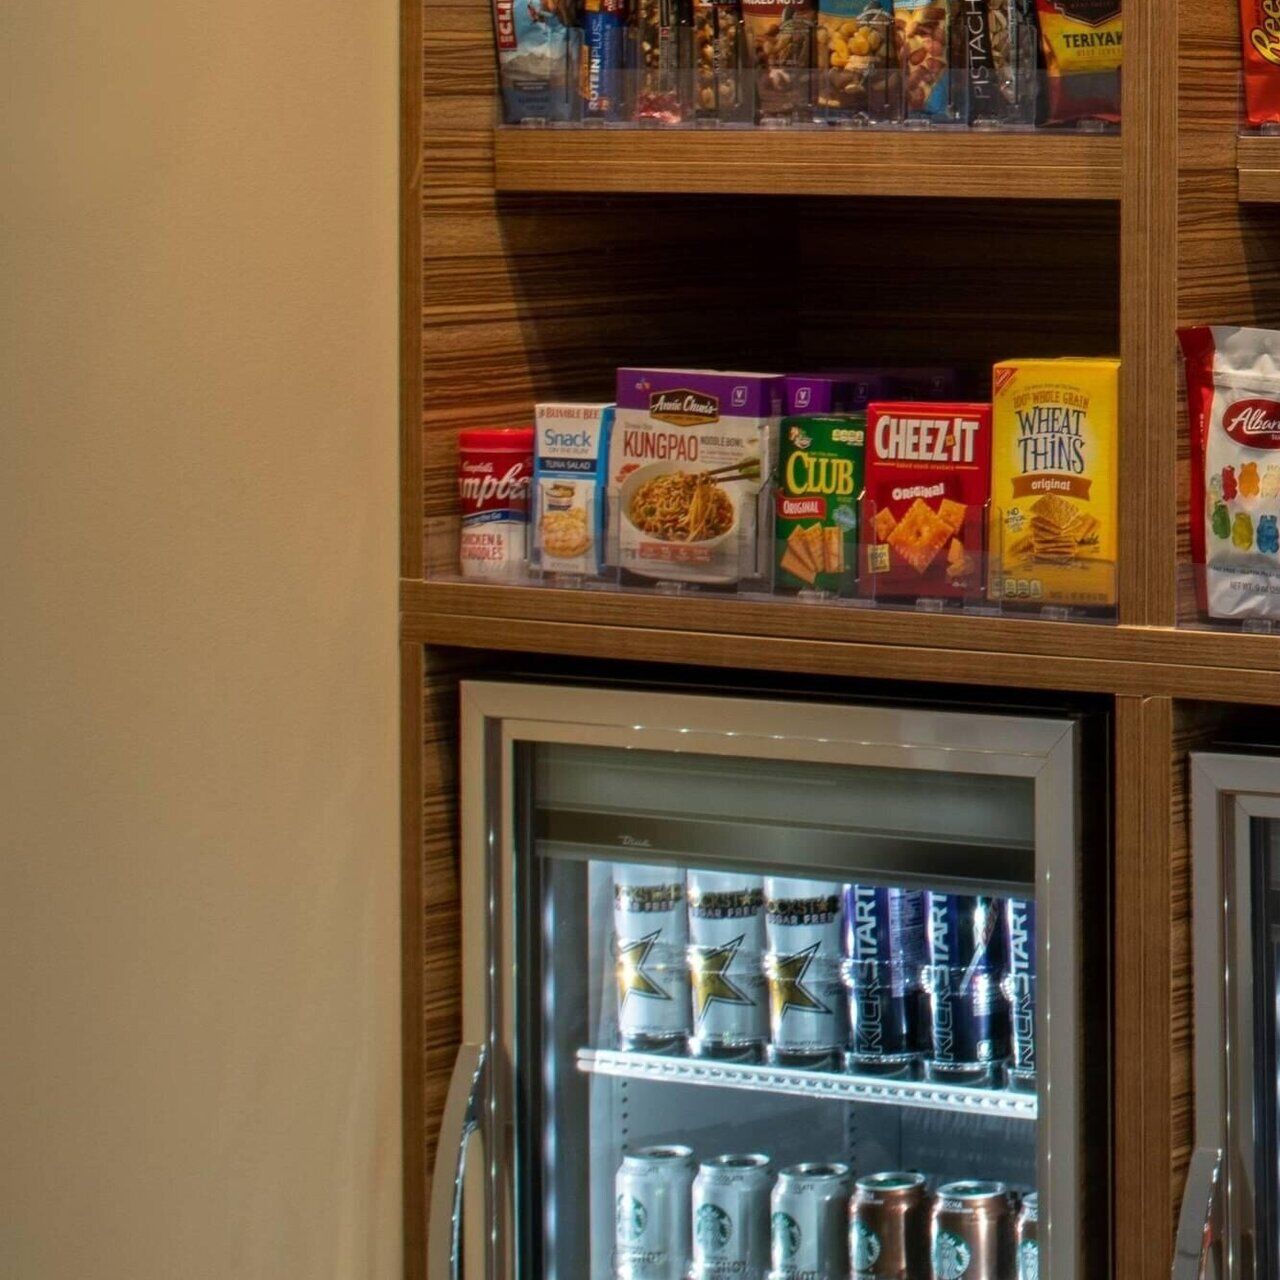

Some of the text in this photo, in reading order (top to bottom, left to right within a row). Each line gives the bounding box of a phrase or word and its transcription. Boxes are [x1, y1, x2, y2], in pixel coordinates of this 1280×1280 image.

[1015, 407, 1086, 436] WHEAT
[544, 429, 591, 447] Snack
[724, 438, 743, 447] BOWL
[568, 460, 591, 470] SALAD
[786, 450, 854, 495] CLUB
[1031, 479, 1071, 491] original
[783, 500, 819, 514] ORIGINAL
